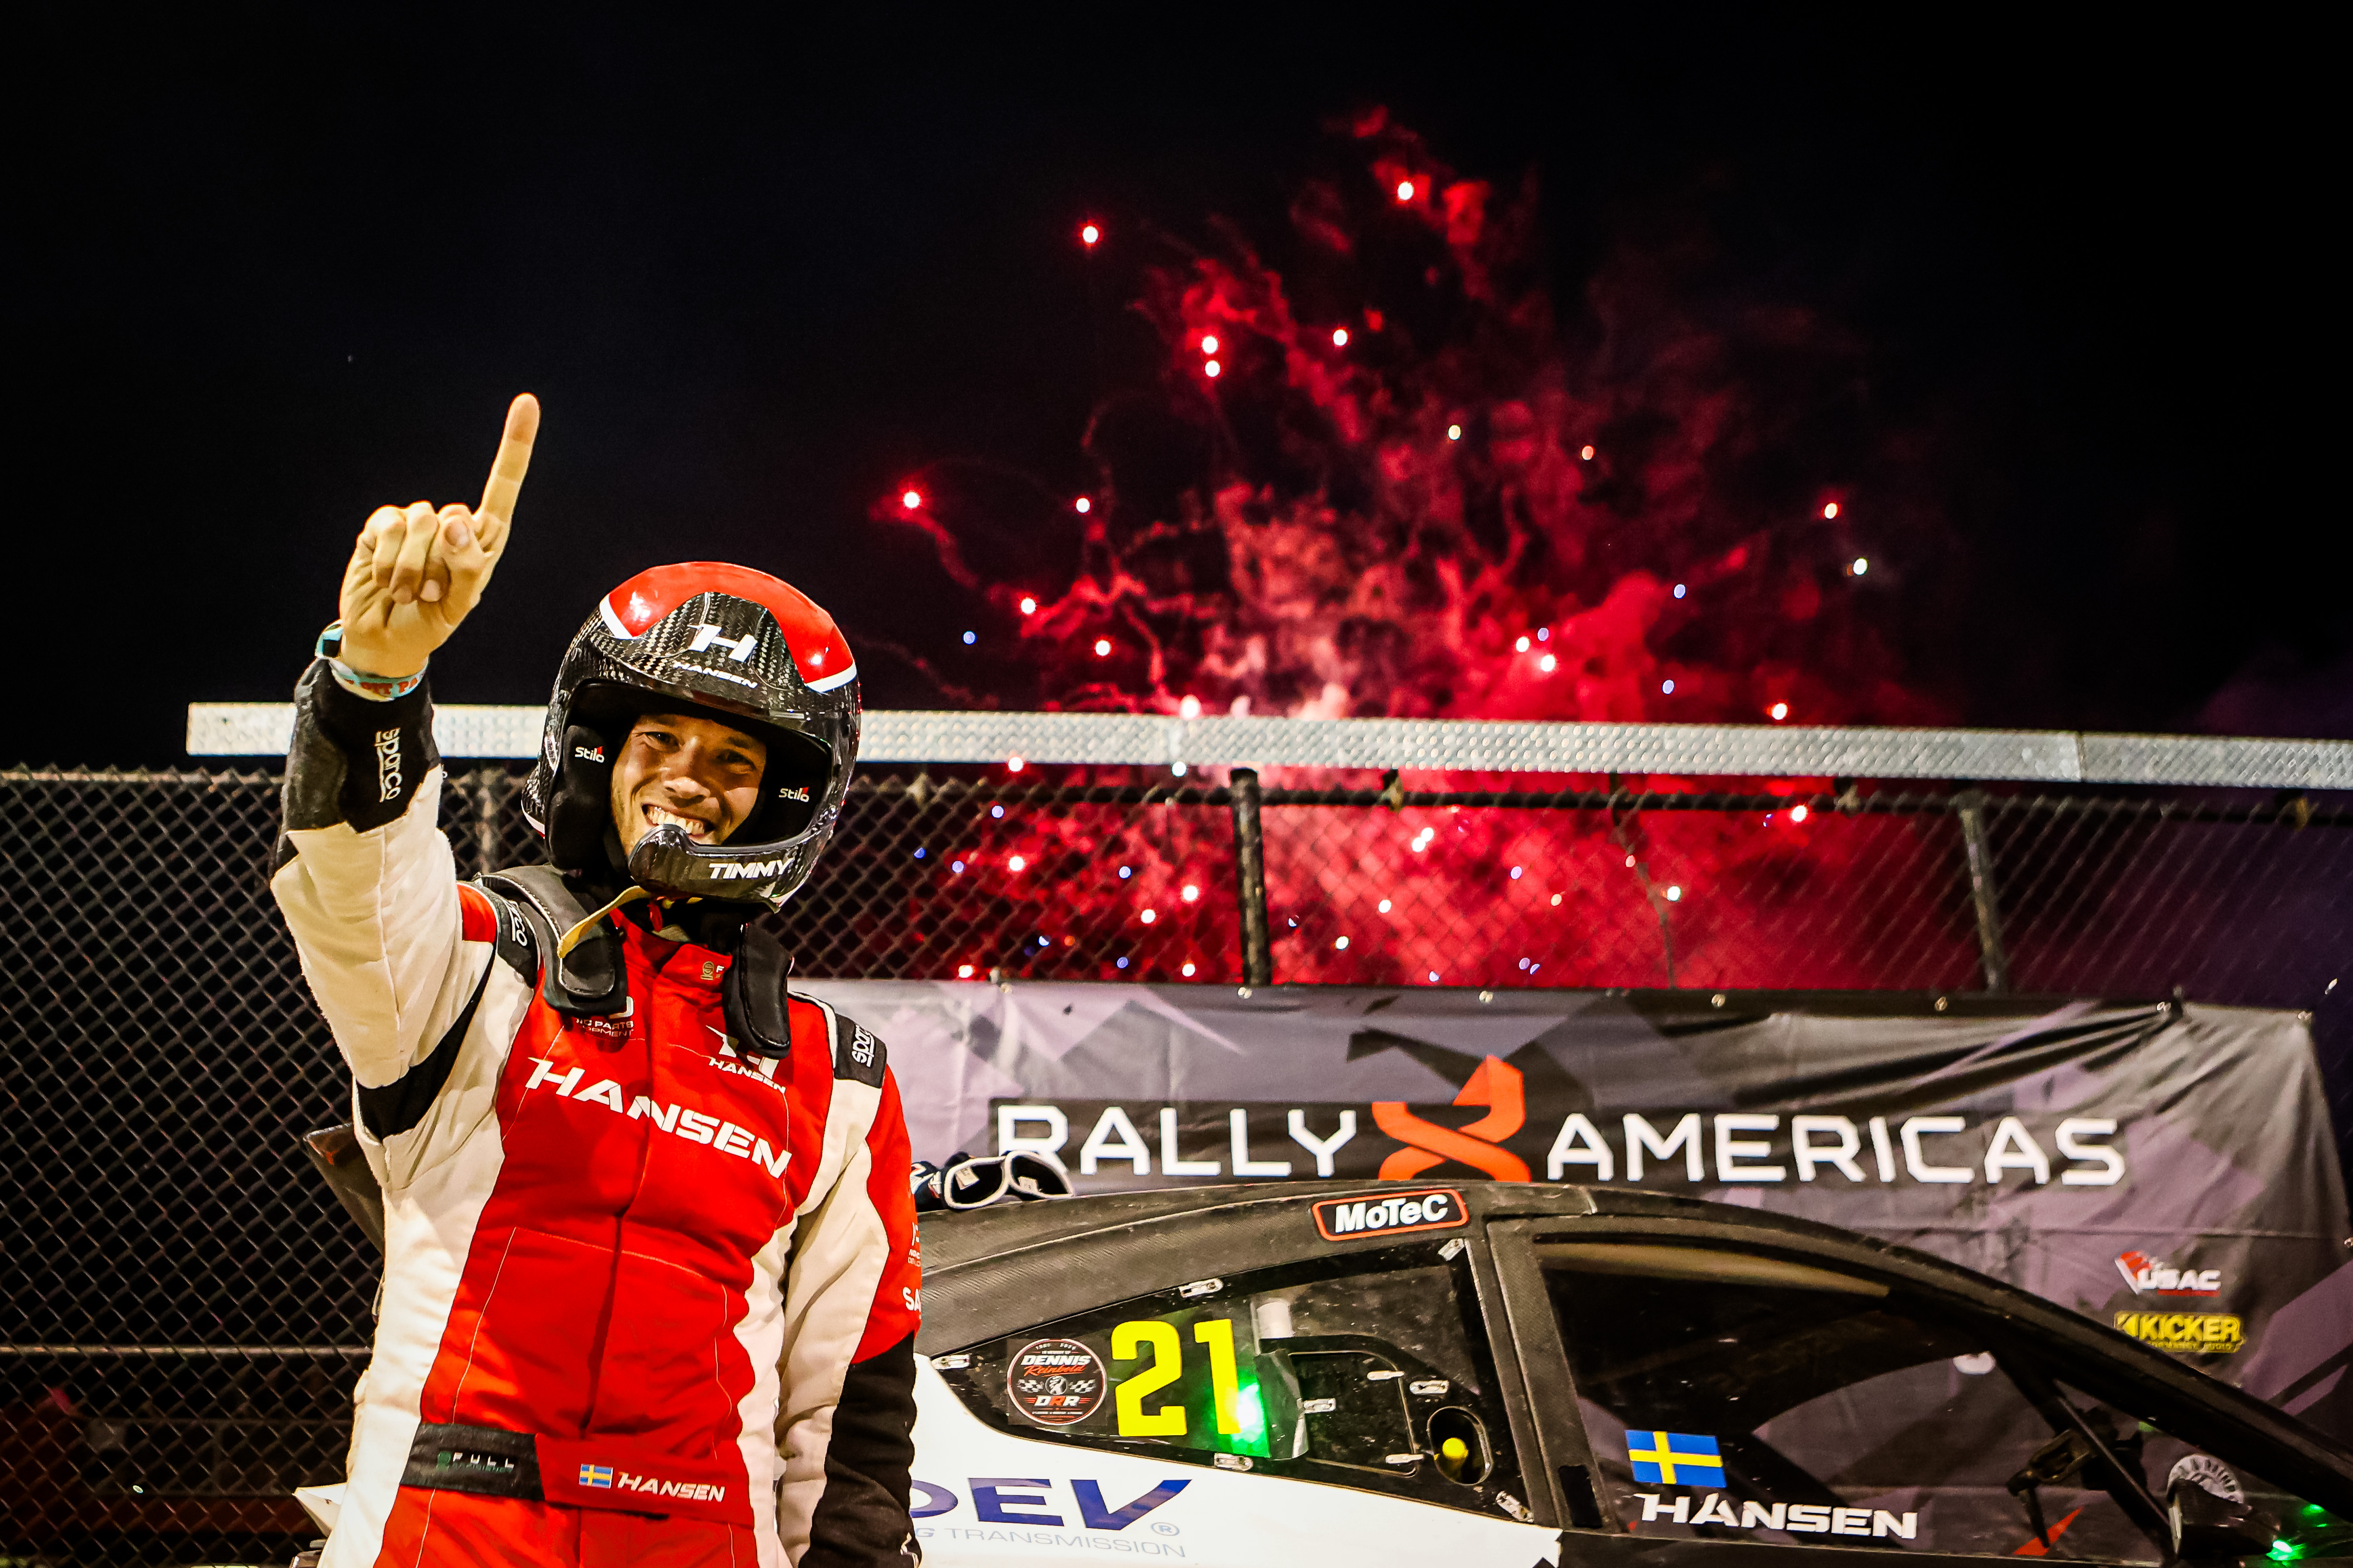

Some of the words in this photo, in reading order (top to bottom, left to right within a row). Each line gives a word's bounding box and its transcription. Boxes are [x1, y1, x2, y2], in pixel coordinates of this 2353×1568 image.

[673, 660, 758, 689] HANSEN
[374, 727, 403, 803] sparco
[575, 745, 605, 763] Stilo
[779, 787, 810, 803] Stilo
[708, 857, 794, 879] TIMMY
[708, 1057, 786, 1094] HANSEN
[526, 1057, 792, 1179] HANSEN
[997, 1105, 1357, 1177] RALLY
[1547, 1113, 2125, 1185] AMERICAS
[1335, 1194, 1448, 1233] MoTeC
[2139, 1315, 2241, 1342] KICKER
[1020, 1355, 1091, 1365] DENNIS
[1110, 1318, 1241, 1437] 21
[1034, 1395, 1080, 1407] DRR
[617, 1472, 725, 1503] HANSEN
[911, 1477, 1193, 1531] DEV
[1633, 1493, 1918, 1539] HANSEN
[944, 1528, 1186, 1557] TRANSMISSION
